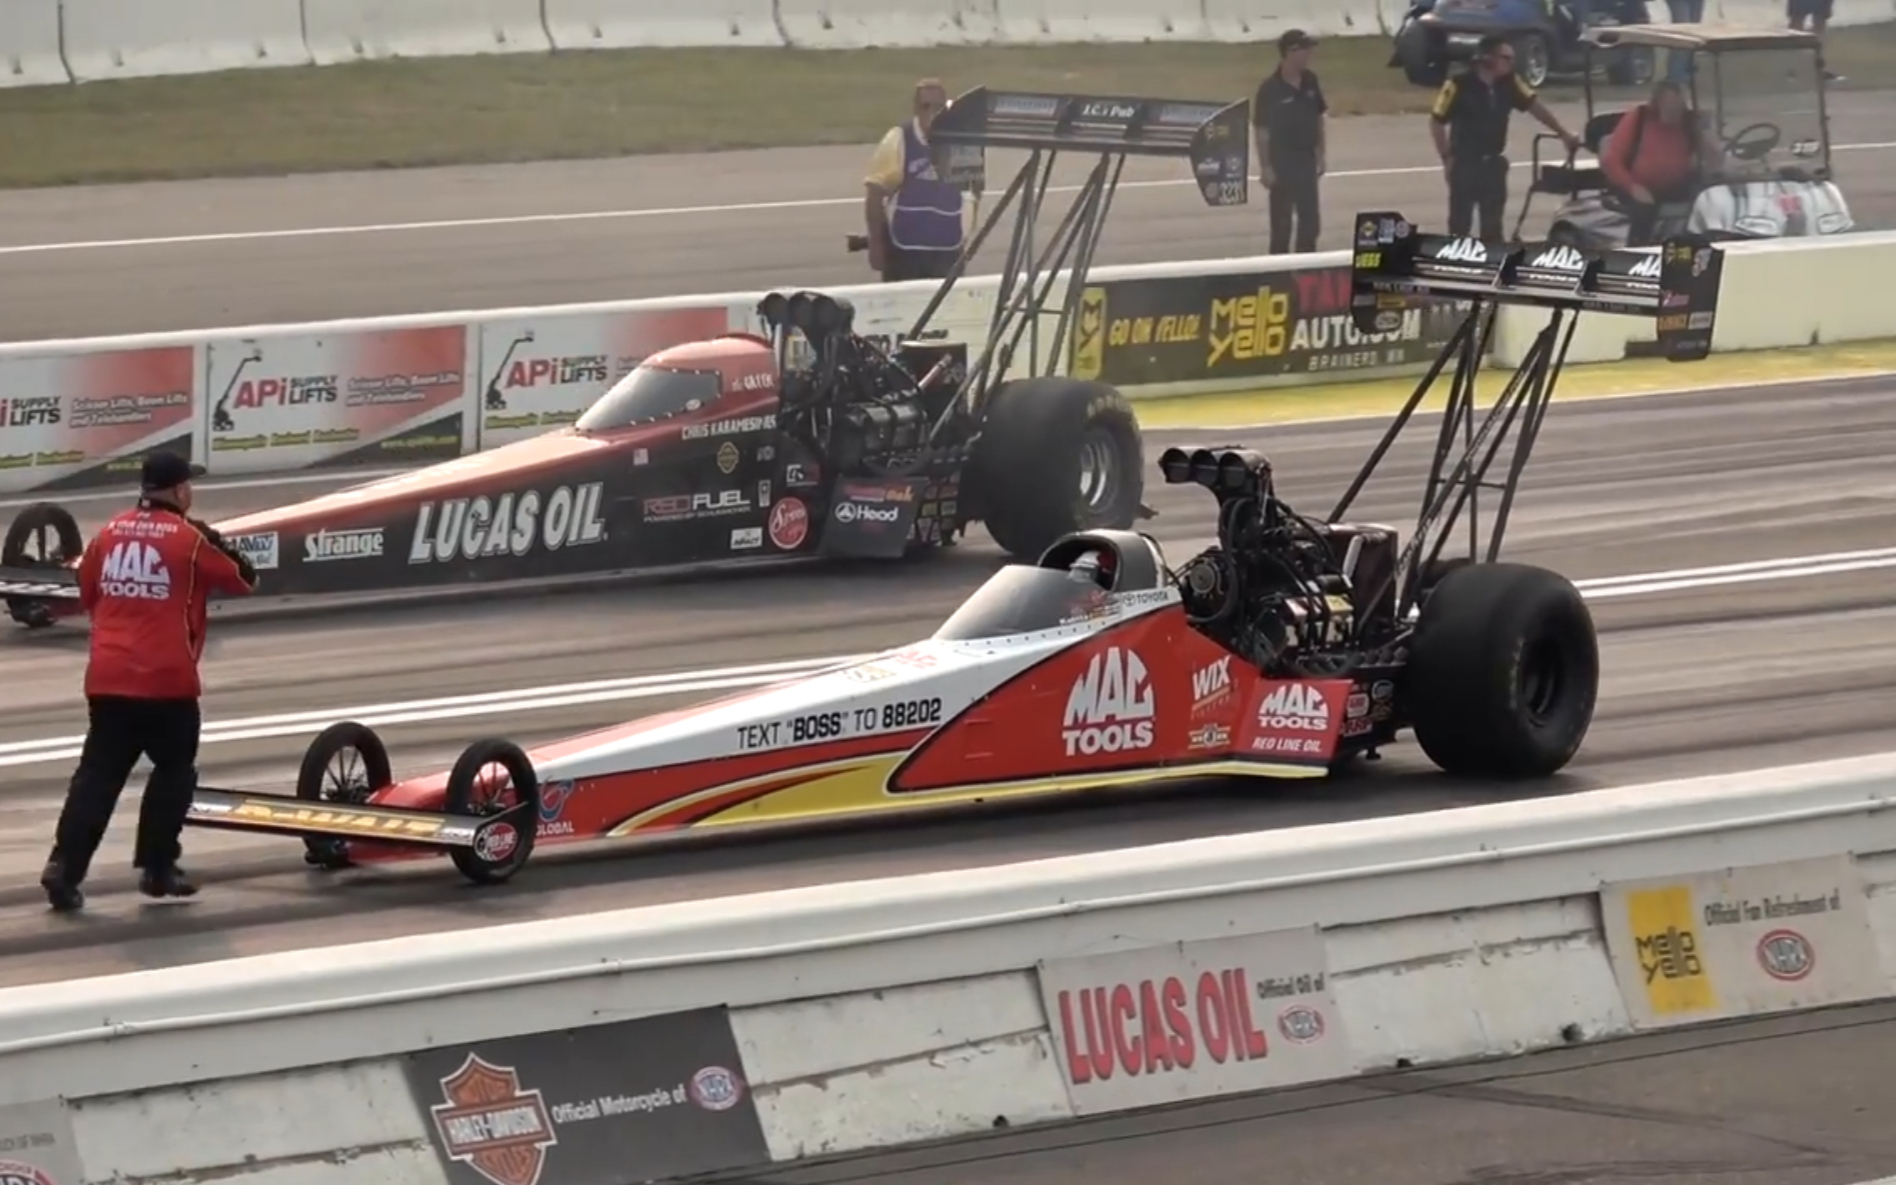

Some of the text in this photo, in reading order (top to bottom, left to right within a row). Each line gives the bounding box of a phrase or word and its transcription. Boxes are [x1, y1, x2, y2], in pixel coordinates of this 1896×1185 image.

[1436, 237, 1487, 262] MAC
[1532, 245, 1584, 270] MAC
[1628, 254, 1661, 276] MA
[1212, 285, 1288, 329] Mello
[1109, 320, 1131, 346] GO
[1132, 316, 1152, 343] ON
[1207, 327, 1288, 368] Yello
[11, 396, 61, 410] SUPPLY
[288, 386, 338, 405] LIFTS
[9, 408, 61, 427] LIFTS
[408, 476, 604, 565] LUCAS OIL
[857, 505, 899, 522] Head
[303, 527, 385, 562] Strange
[101, 541, 170, 585] MAC
[101, 581, 170, 599] TOOLS
[1063, 646, 1155, 728] MAC
[1192, 653, 1232, 701] WIX
[1259, 683, 1330, 718] MAC
[737, 722, 782, 749] TEXT
[854, 708, 877, 731] TO
[882, 698, 943, 728] 88202
[1062, 720, 1155, 757] TOOLS
[1258, 714, 1329, 731] TOOLS
[1252, 737, 1323, 752] RED LINE OIL
[1635, 926, 1695, 960] Mello
[1641, 955, 1701, 986] Yello
[1058, 967, 1268, 1086] LUCAS OIL
[551, 1083, 688, 1125] Official Motorcycle of
